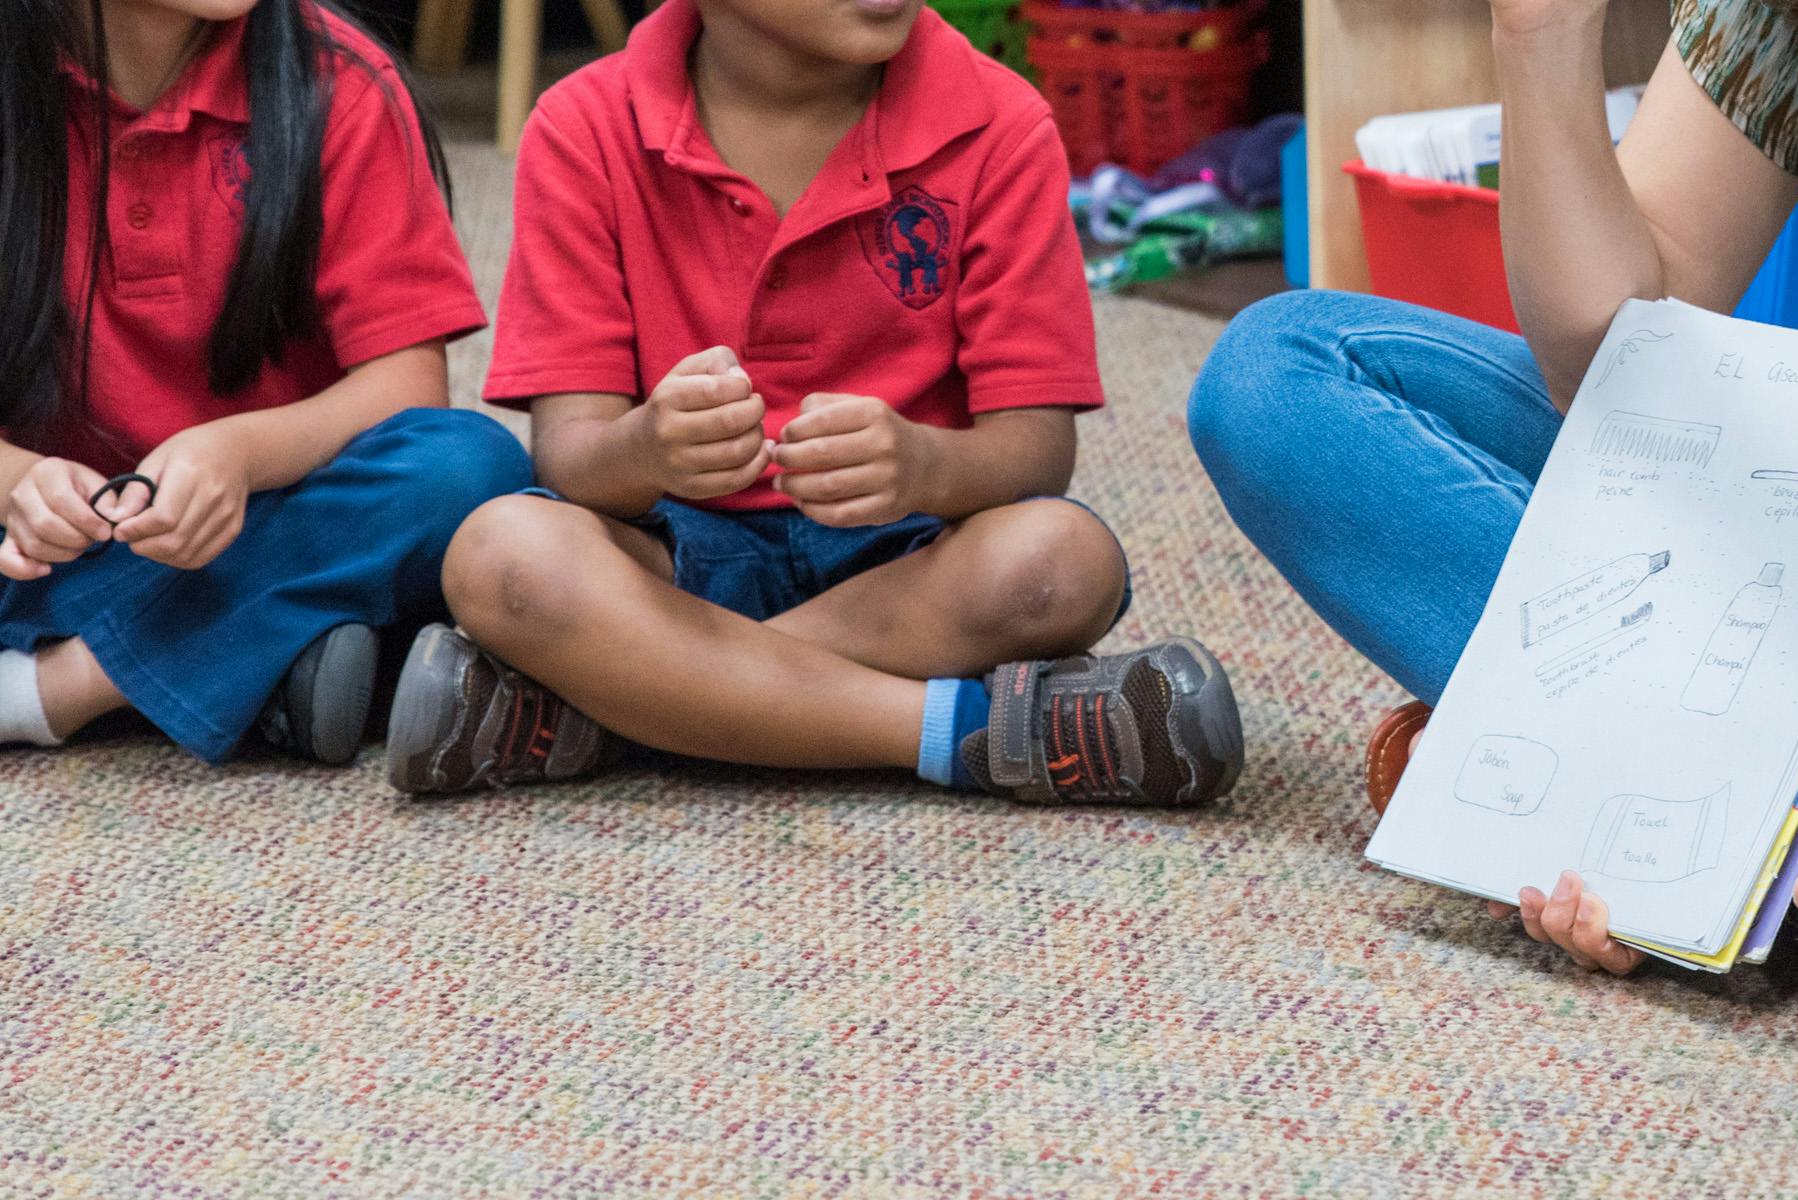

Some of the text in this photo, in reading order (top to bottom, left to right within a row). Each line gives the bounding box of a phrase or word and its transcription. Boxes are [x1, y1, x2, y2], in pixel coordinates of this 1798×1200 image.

[1598, 464, 1662, 481] hair comb
[1595, 485, 1634, 501] peine
[1536, 575, 1604, 610] Toothpaste
[1538, 576, 1636, 638] pasta de dientes
[1725, 613, 1767, 636] Shampoo
[1584, 665, 1599, 678] de
[1605, 636, 1648, 666] dientes
